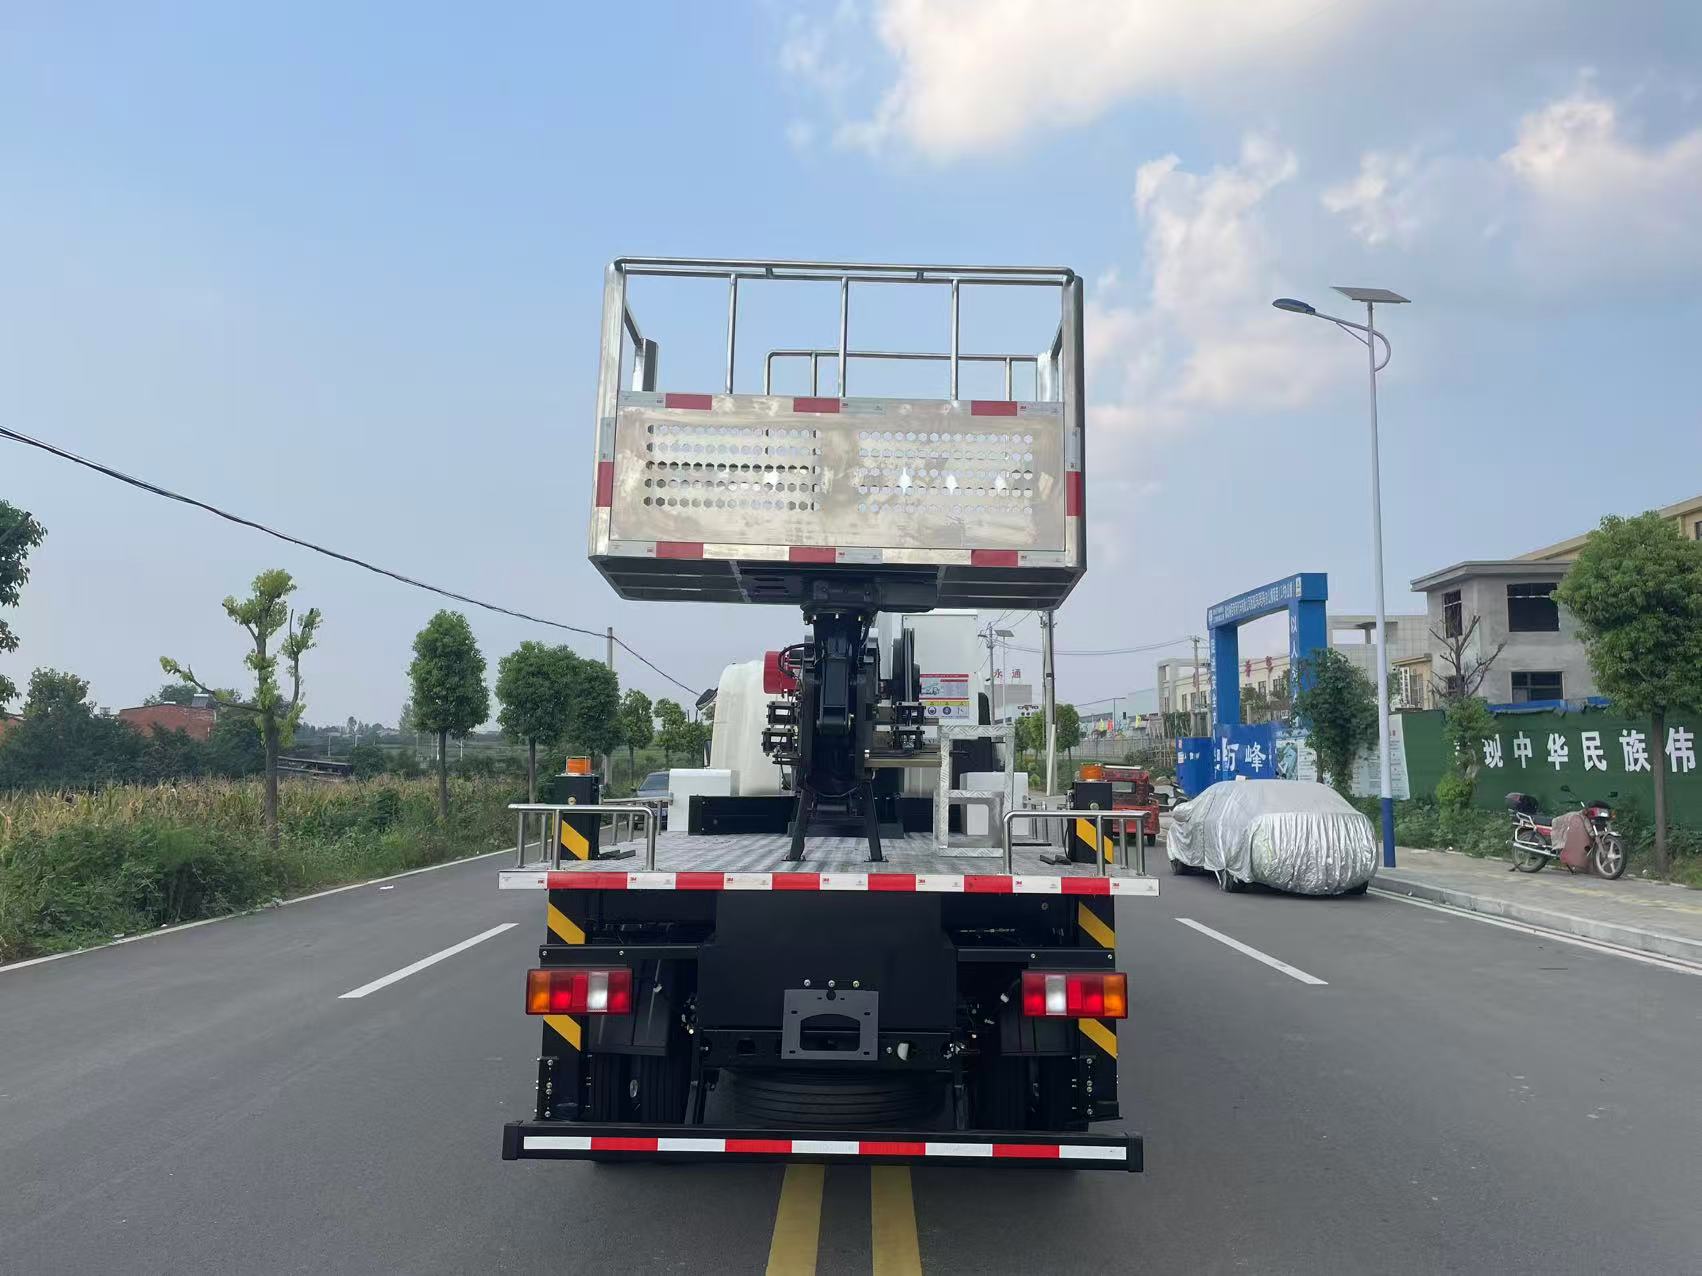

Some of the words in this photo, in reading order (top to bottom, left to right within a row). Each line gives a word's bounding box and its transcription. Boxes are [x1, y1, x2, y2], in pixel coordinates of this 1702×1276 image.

[1454, 726, 1697, 773] 现中华民族伟
